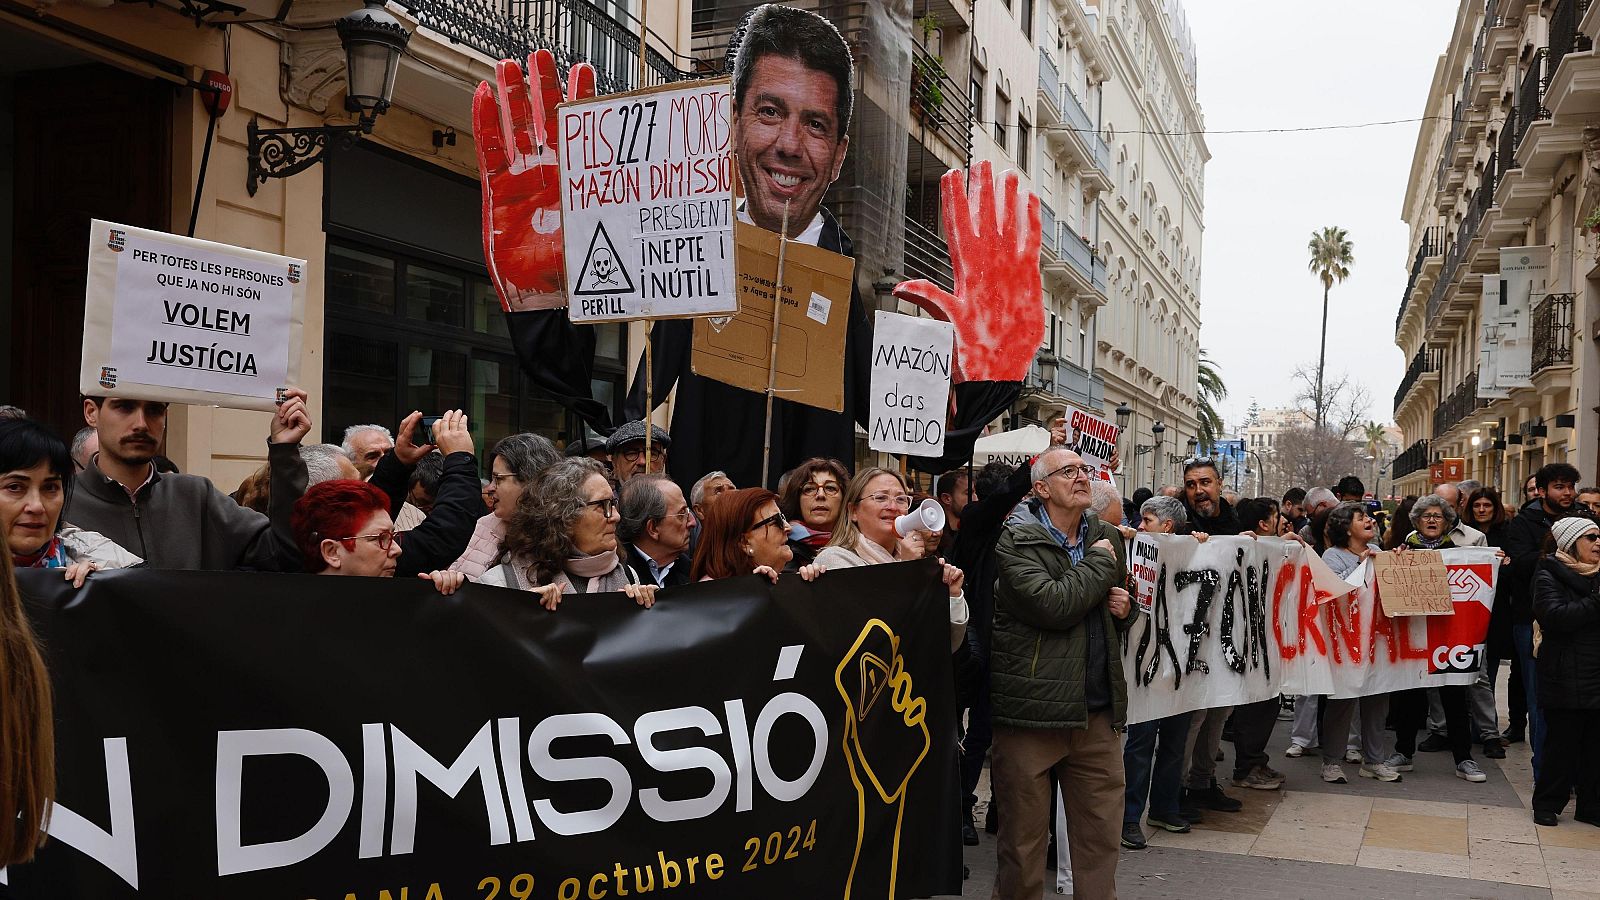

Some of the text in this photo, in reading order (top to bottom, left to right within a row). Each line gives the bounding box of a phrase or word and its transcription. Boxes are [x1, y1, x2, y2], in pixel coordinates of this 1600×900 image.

[209, 80, 231, 93] FUEGO
[565, 91, 731, 170] PELS 227 MORTS
[568, 164, 641, 211] MAZÓN
[132, 249, 158, 265] PER
[160, 255, 198, 272] TOTES
[200, 262, 222, 276] LES
[224, 267, 284, 287] PERSONES
[156, 273, 261, 301] QUE JA NO HI SÓN
[750, 286, 768, 298] Baby
[769, 293, 799, 308] Foldale
[163, 300, 250, 334] VOLEM
[147, 341, 258, 375] JUSTÍCIA
[884, 382, 924, 411] das
[872, 416, 942, 446] MIEDO
[1070, 410, 1119, 444] CRIMINAL
[1080, 432, 1116, 462] MAZÓN
[1136, 541, 1158, 563] MAZÓN
[1133, 563, 1156, 583] PRISIÓN
[1431, 643, 1486, 670] CGT
[216, 645, 828, 876] DIMISSIÓ
[477, 819, 817, 900] 29 octubre 2024
